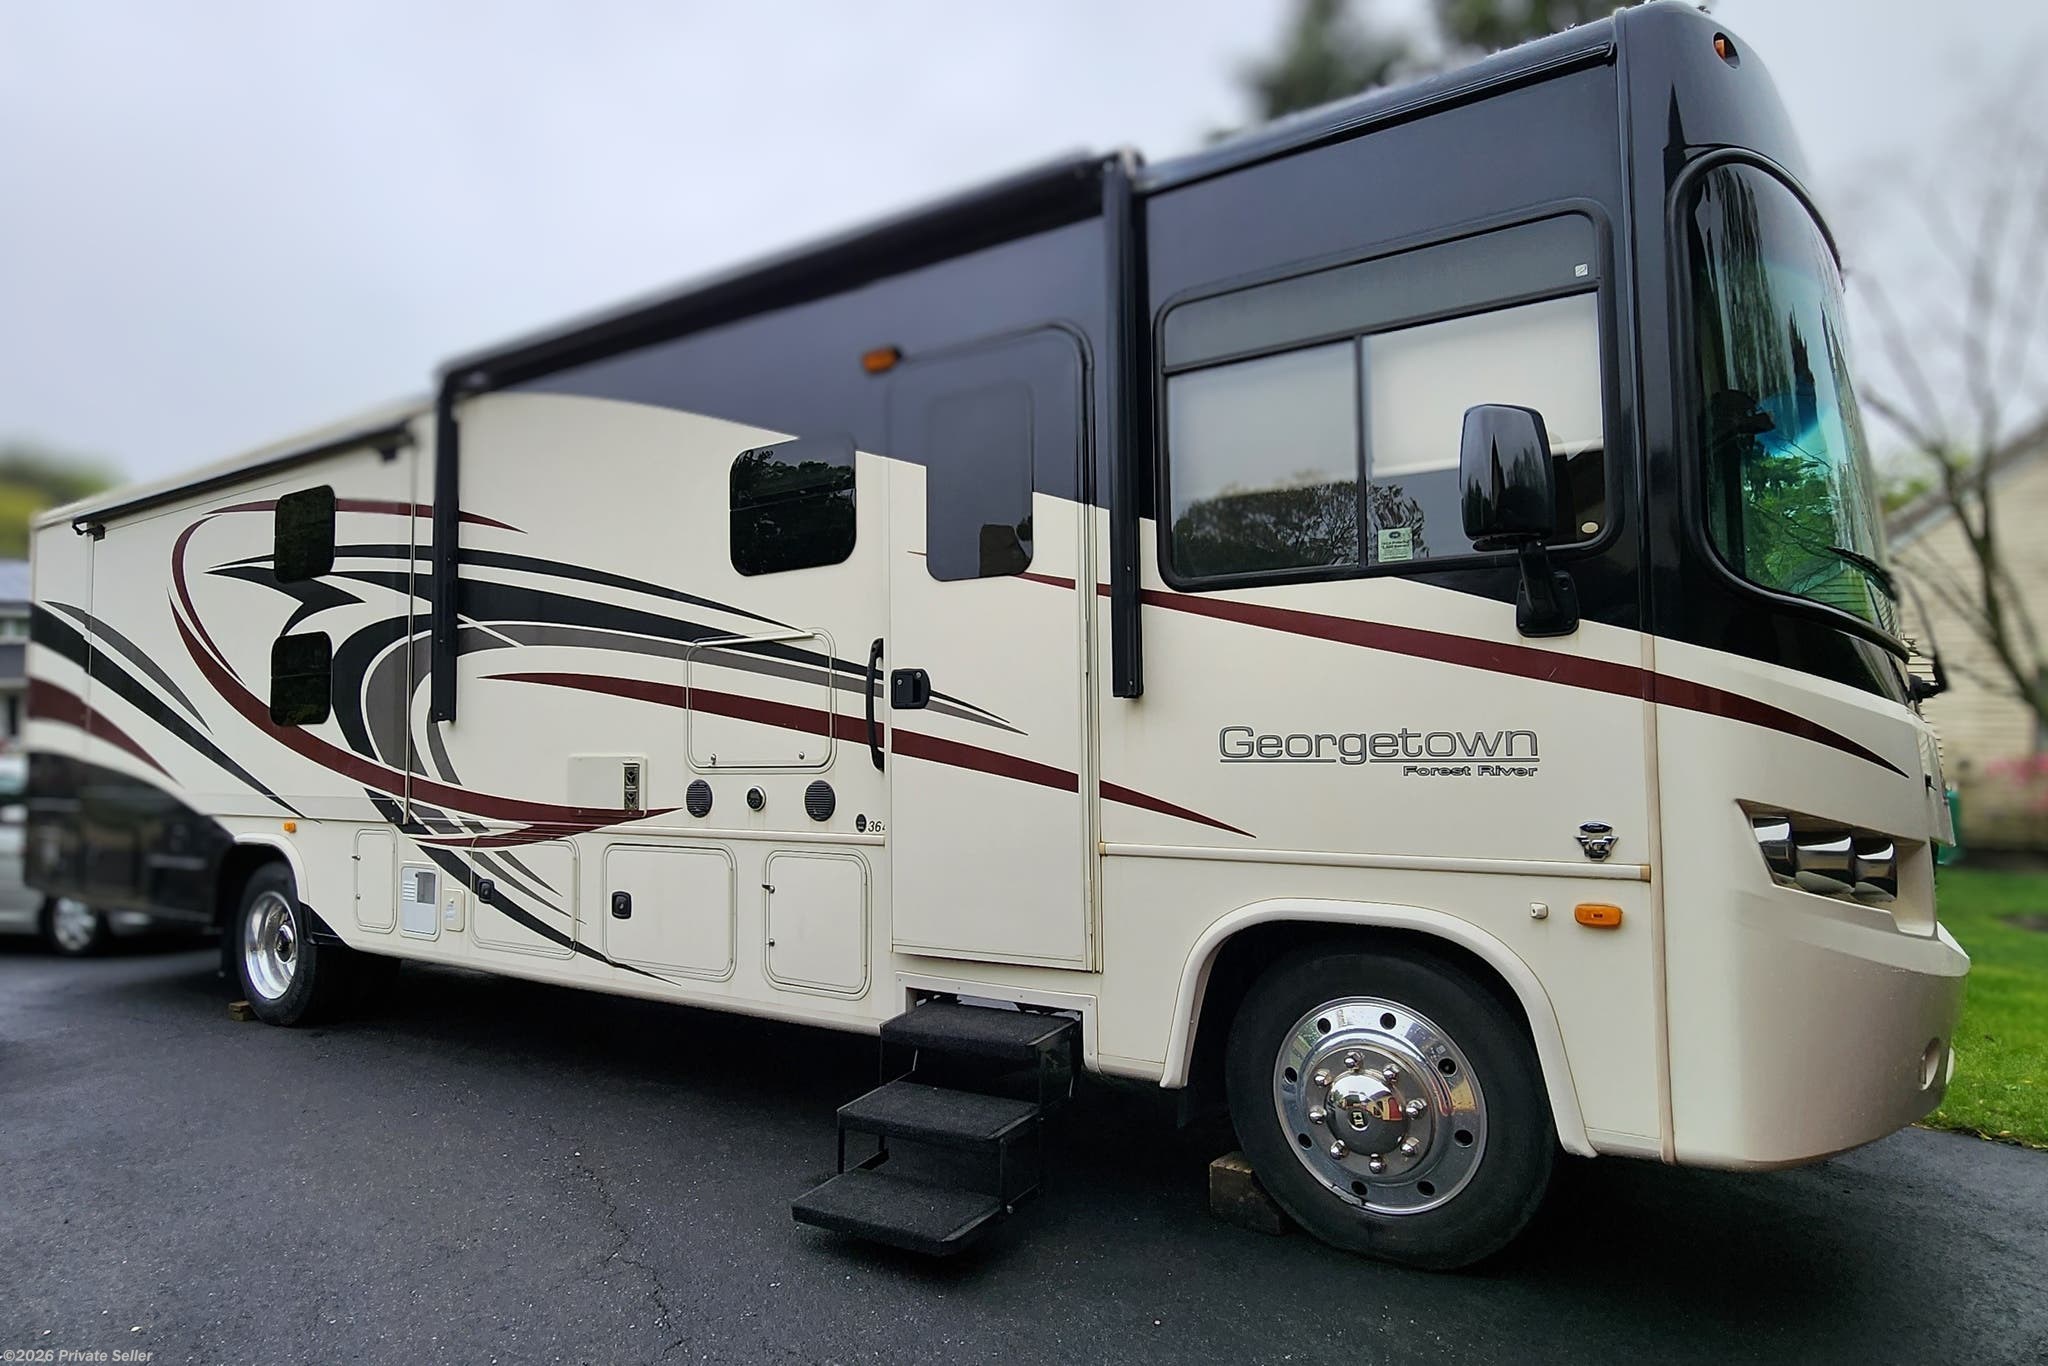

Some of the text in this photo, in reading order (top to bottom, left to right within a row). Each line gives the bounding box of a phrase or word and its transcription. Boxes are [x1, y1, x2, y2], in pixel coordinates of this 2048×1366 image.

[1219, 726, 1539, 765] Georgetown
[1403, 765, 1538, 777] Forest River
